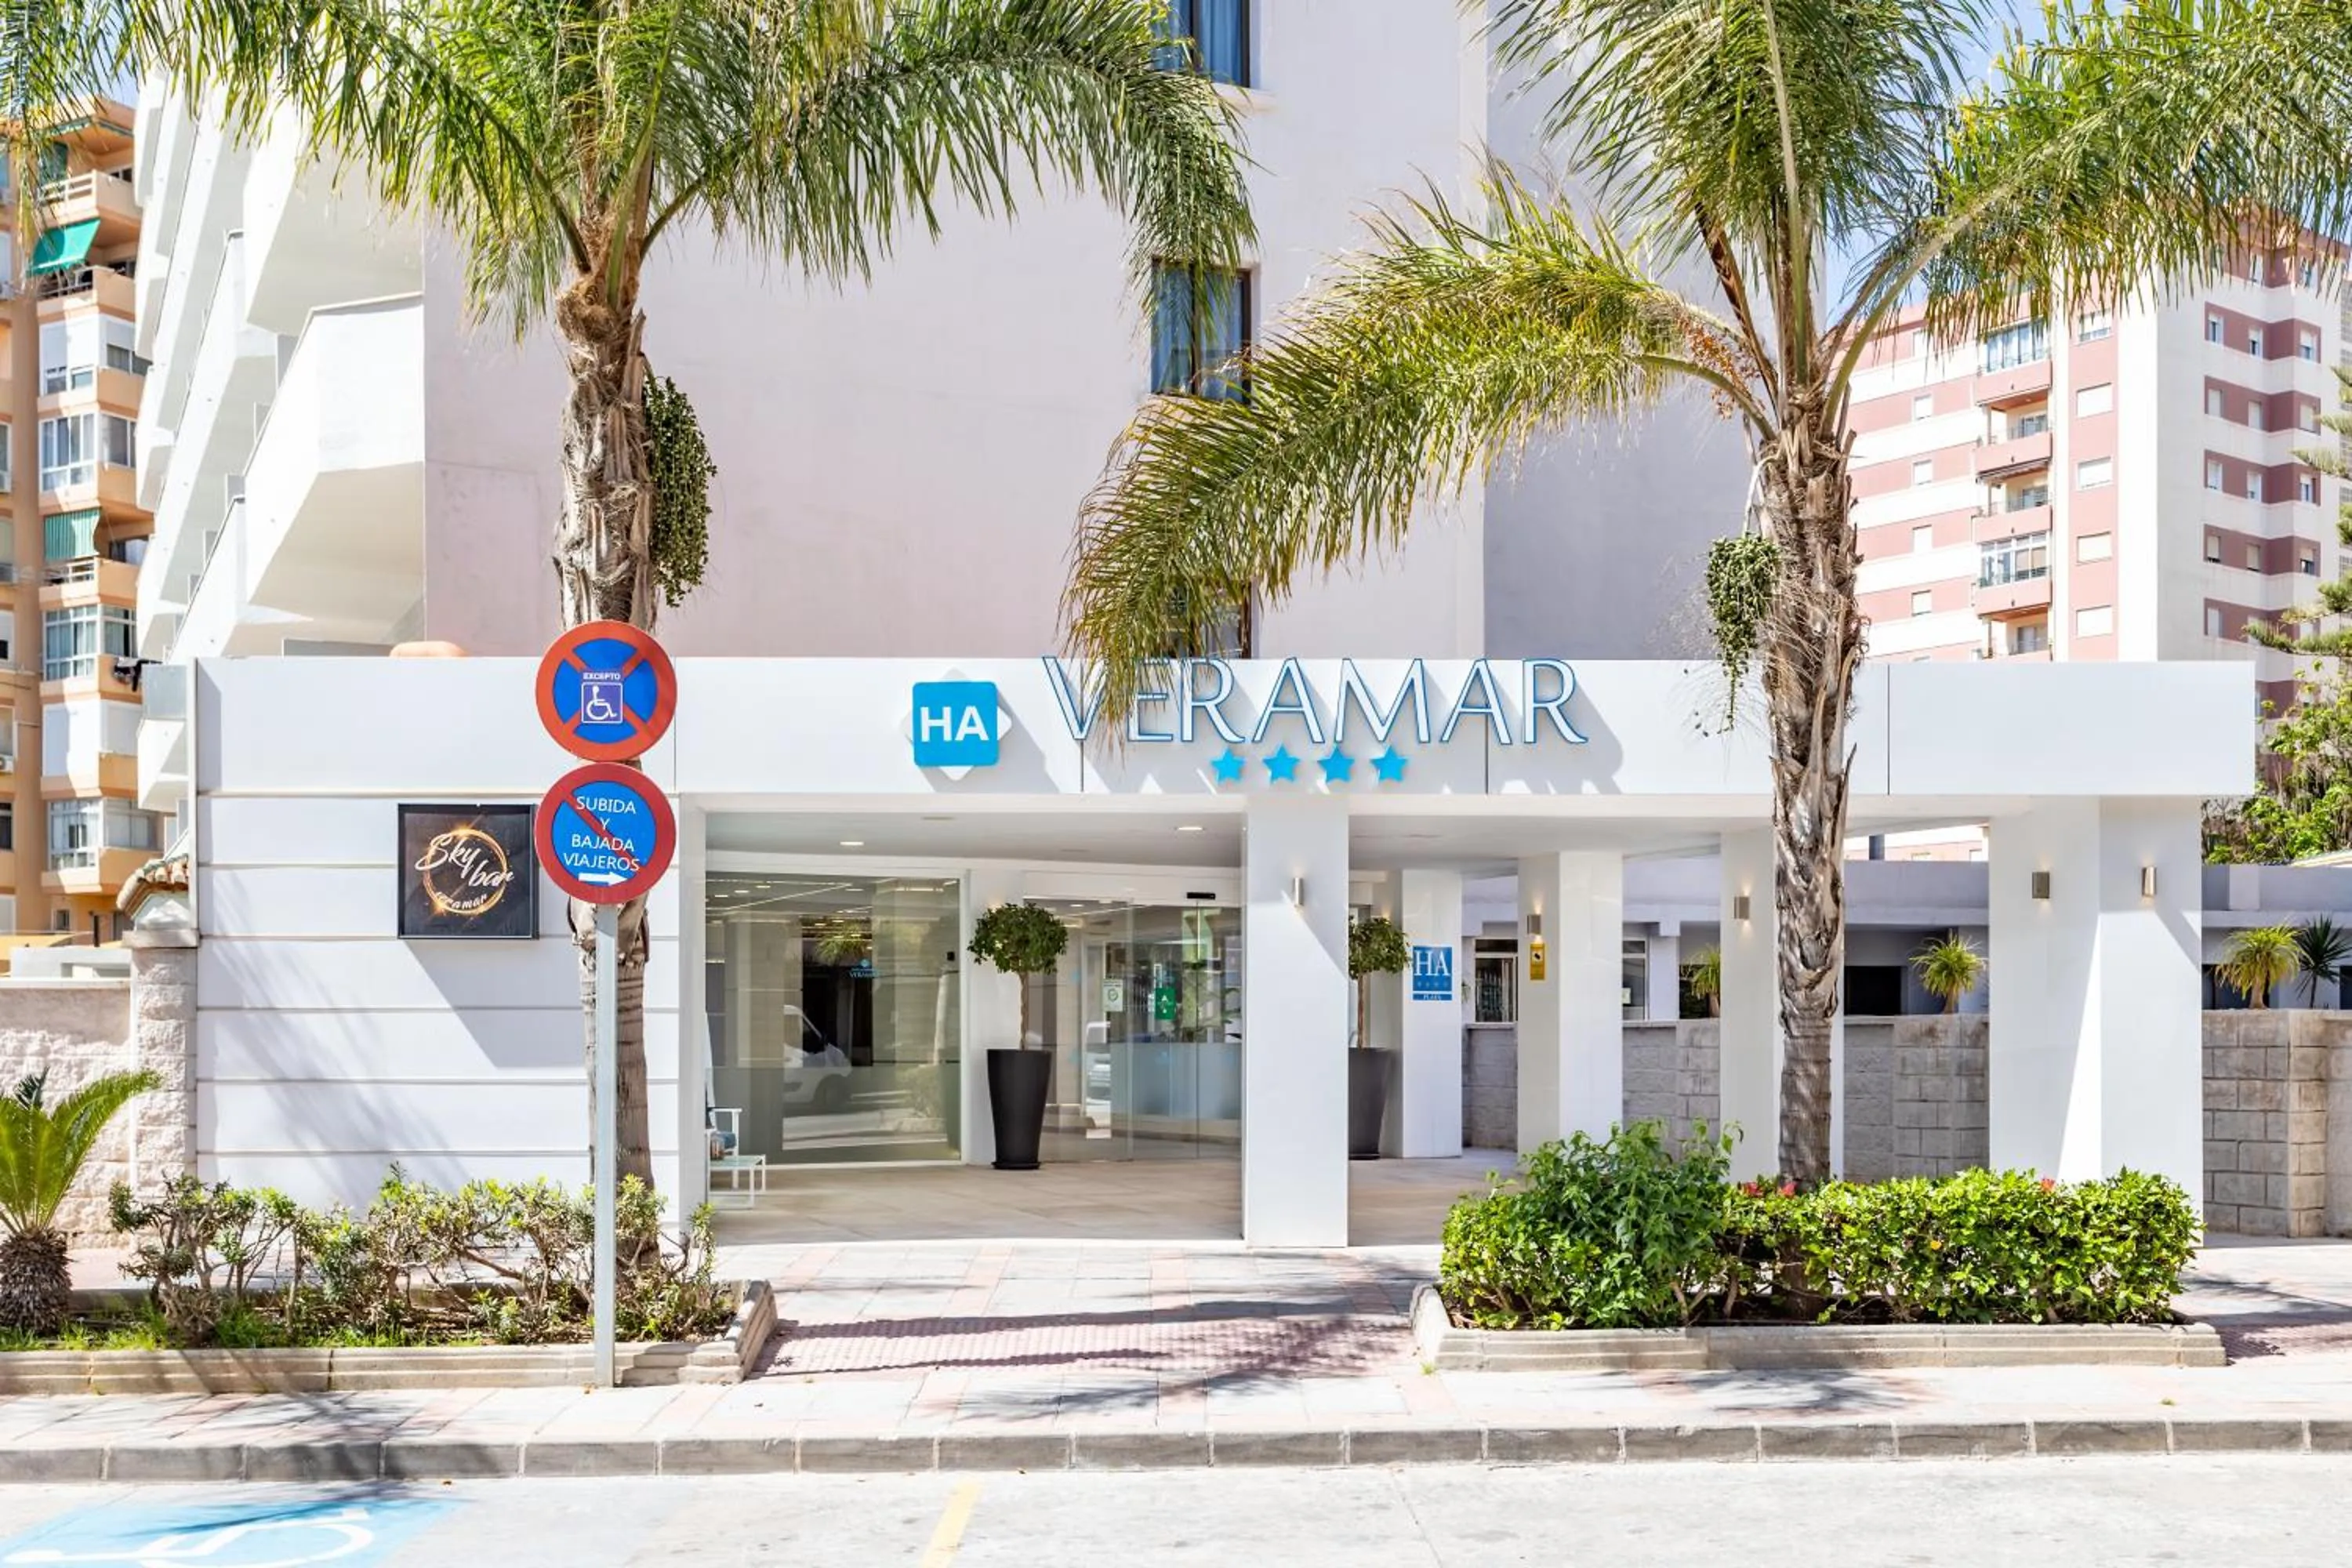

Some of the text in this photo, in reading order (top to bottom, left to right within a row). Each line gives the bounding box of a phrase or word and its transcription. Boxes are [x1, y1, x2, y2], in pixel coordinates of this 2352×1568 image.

[920, 706, 989, 742] HA
[575, 796, 637, 815] SUBIDA
[599, 817, 611, 830] Y
[571, 833, 635, 852] BAJADA
[414, 833, 481, 879] Sky
[562, 852, 641, 872] VIAJEROS
[468, 859, 515, 887] bar
[1413, 950, 1451, 976] HA
